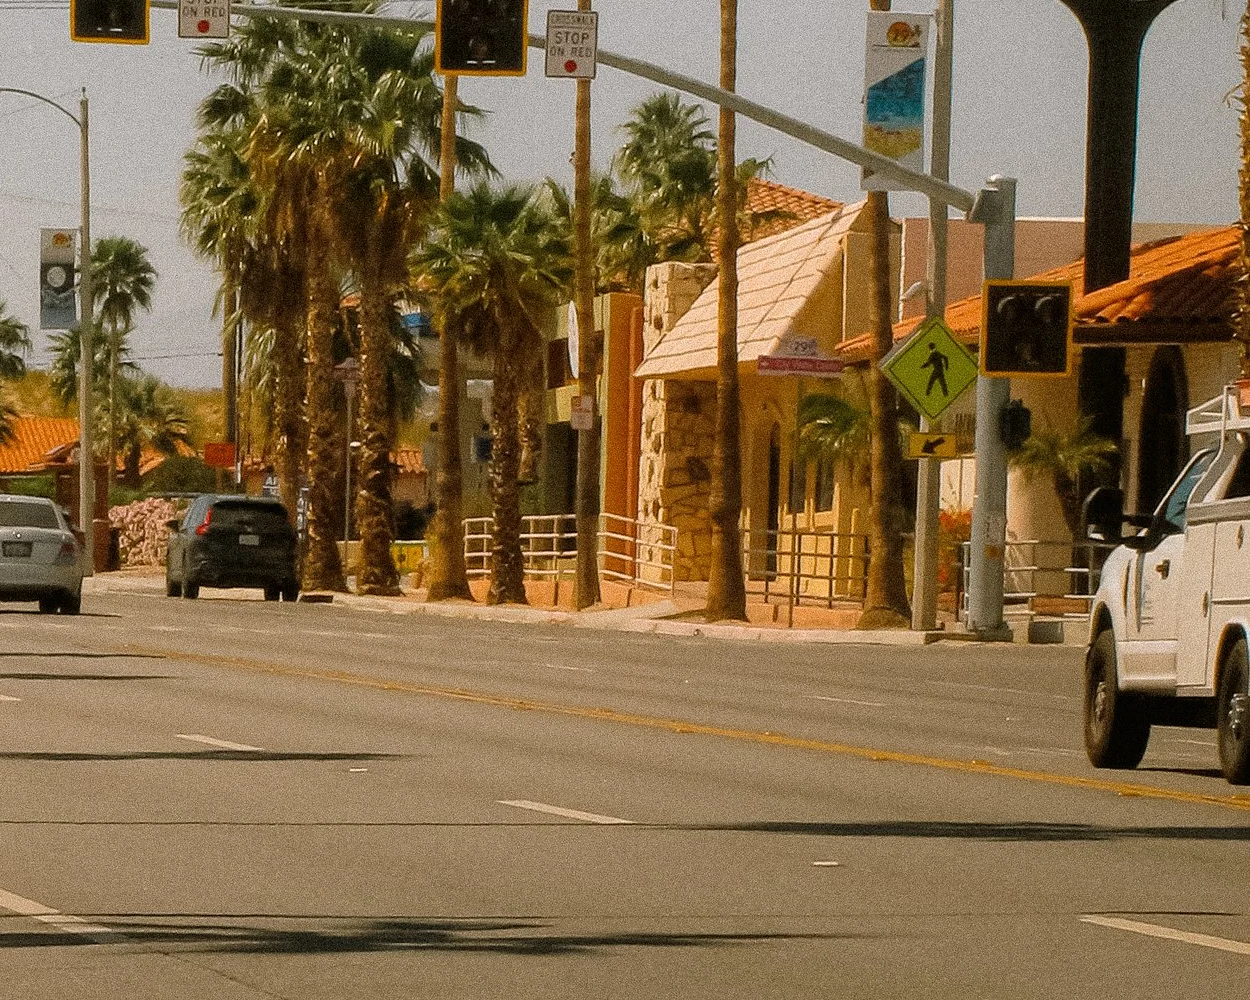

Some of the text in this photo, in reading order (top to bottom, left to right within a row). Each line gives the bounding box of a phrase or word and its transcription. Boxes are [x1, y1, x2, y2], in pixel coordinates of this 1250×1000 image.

[182, 6, 226, 17] ON RED
[555, 31, 589, 45] STOP
[550, 46, 592, 57] ON RED
